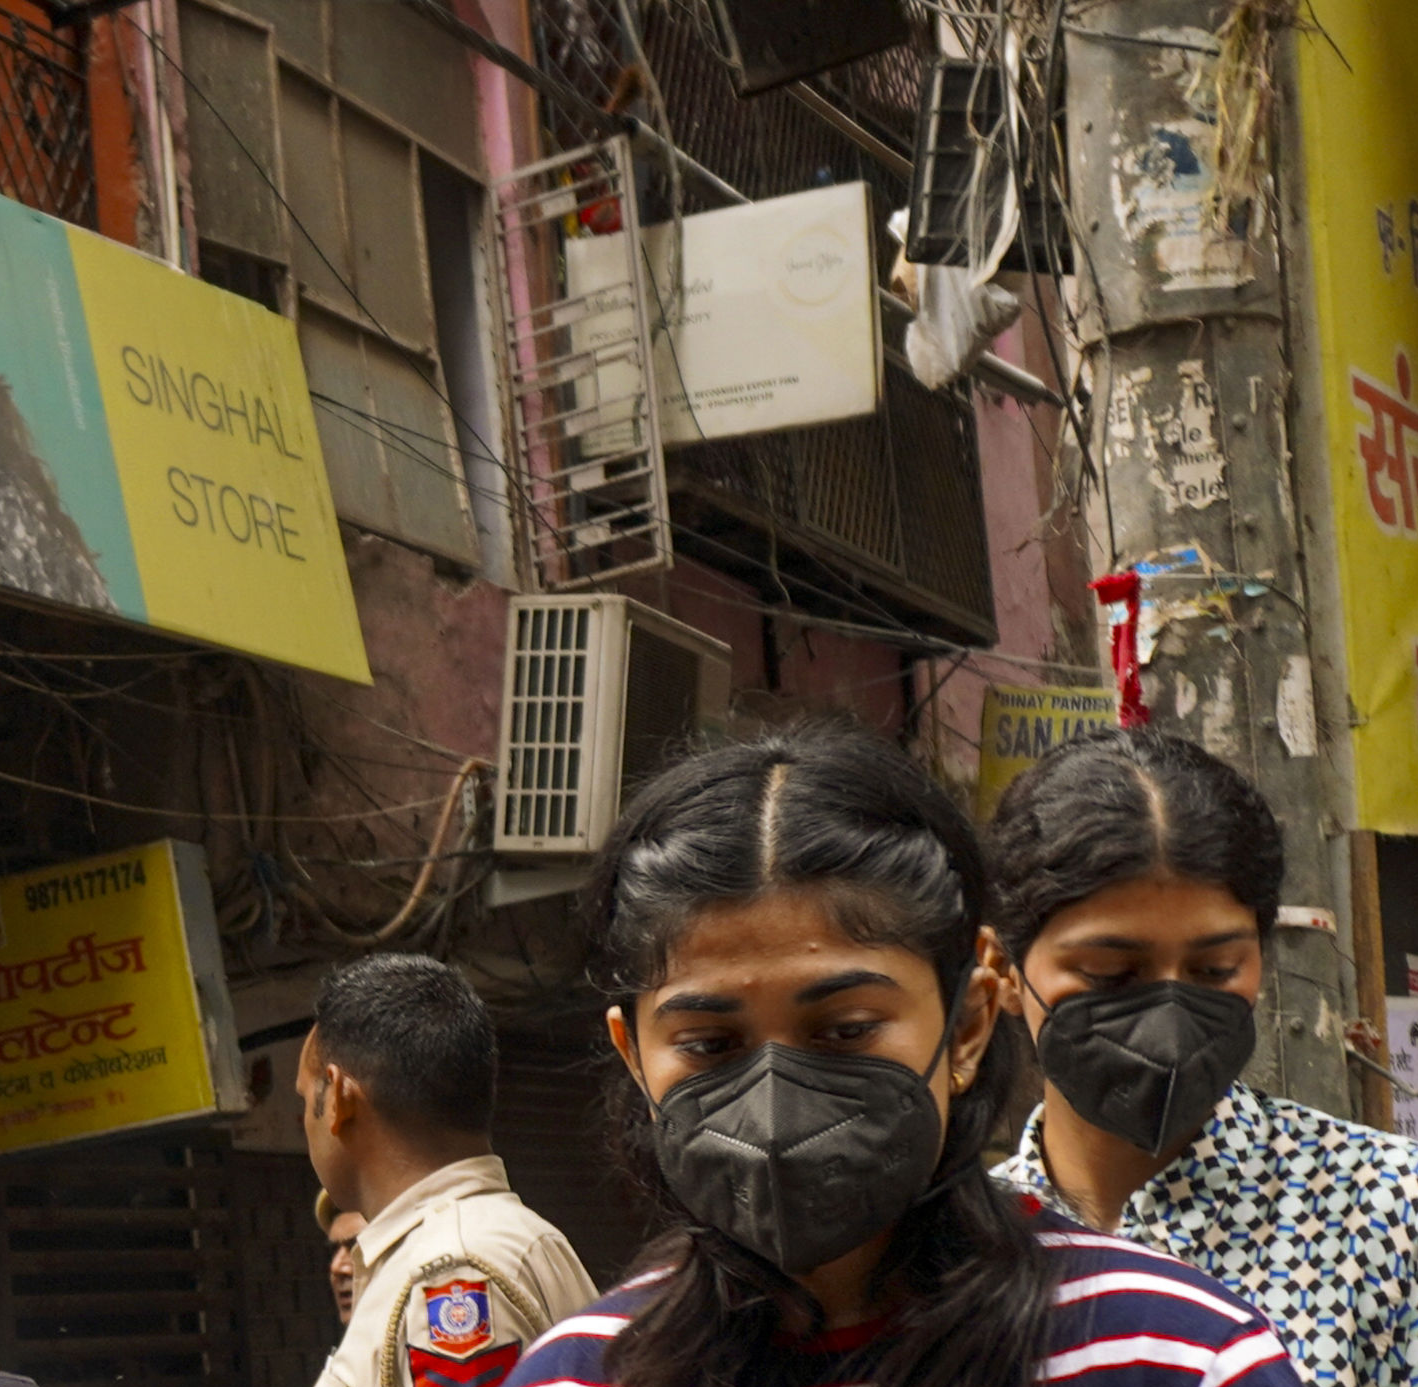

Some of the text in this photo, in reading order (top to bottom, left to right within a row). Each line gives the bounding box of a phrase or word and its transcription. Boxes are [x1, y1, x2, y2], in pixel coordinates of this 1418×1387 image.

[121, 345, 302, 461] SINGHAL
[167, 467, 306, 562] STORE
[24, 860, 146, 911] 9871177174
